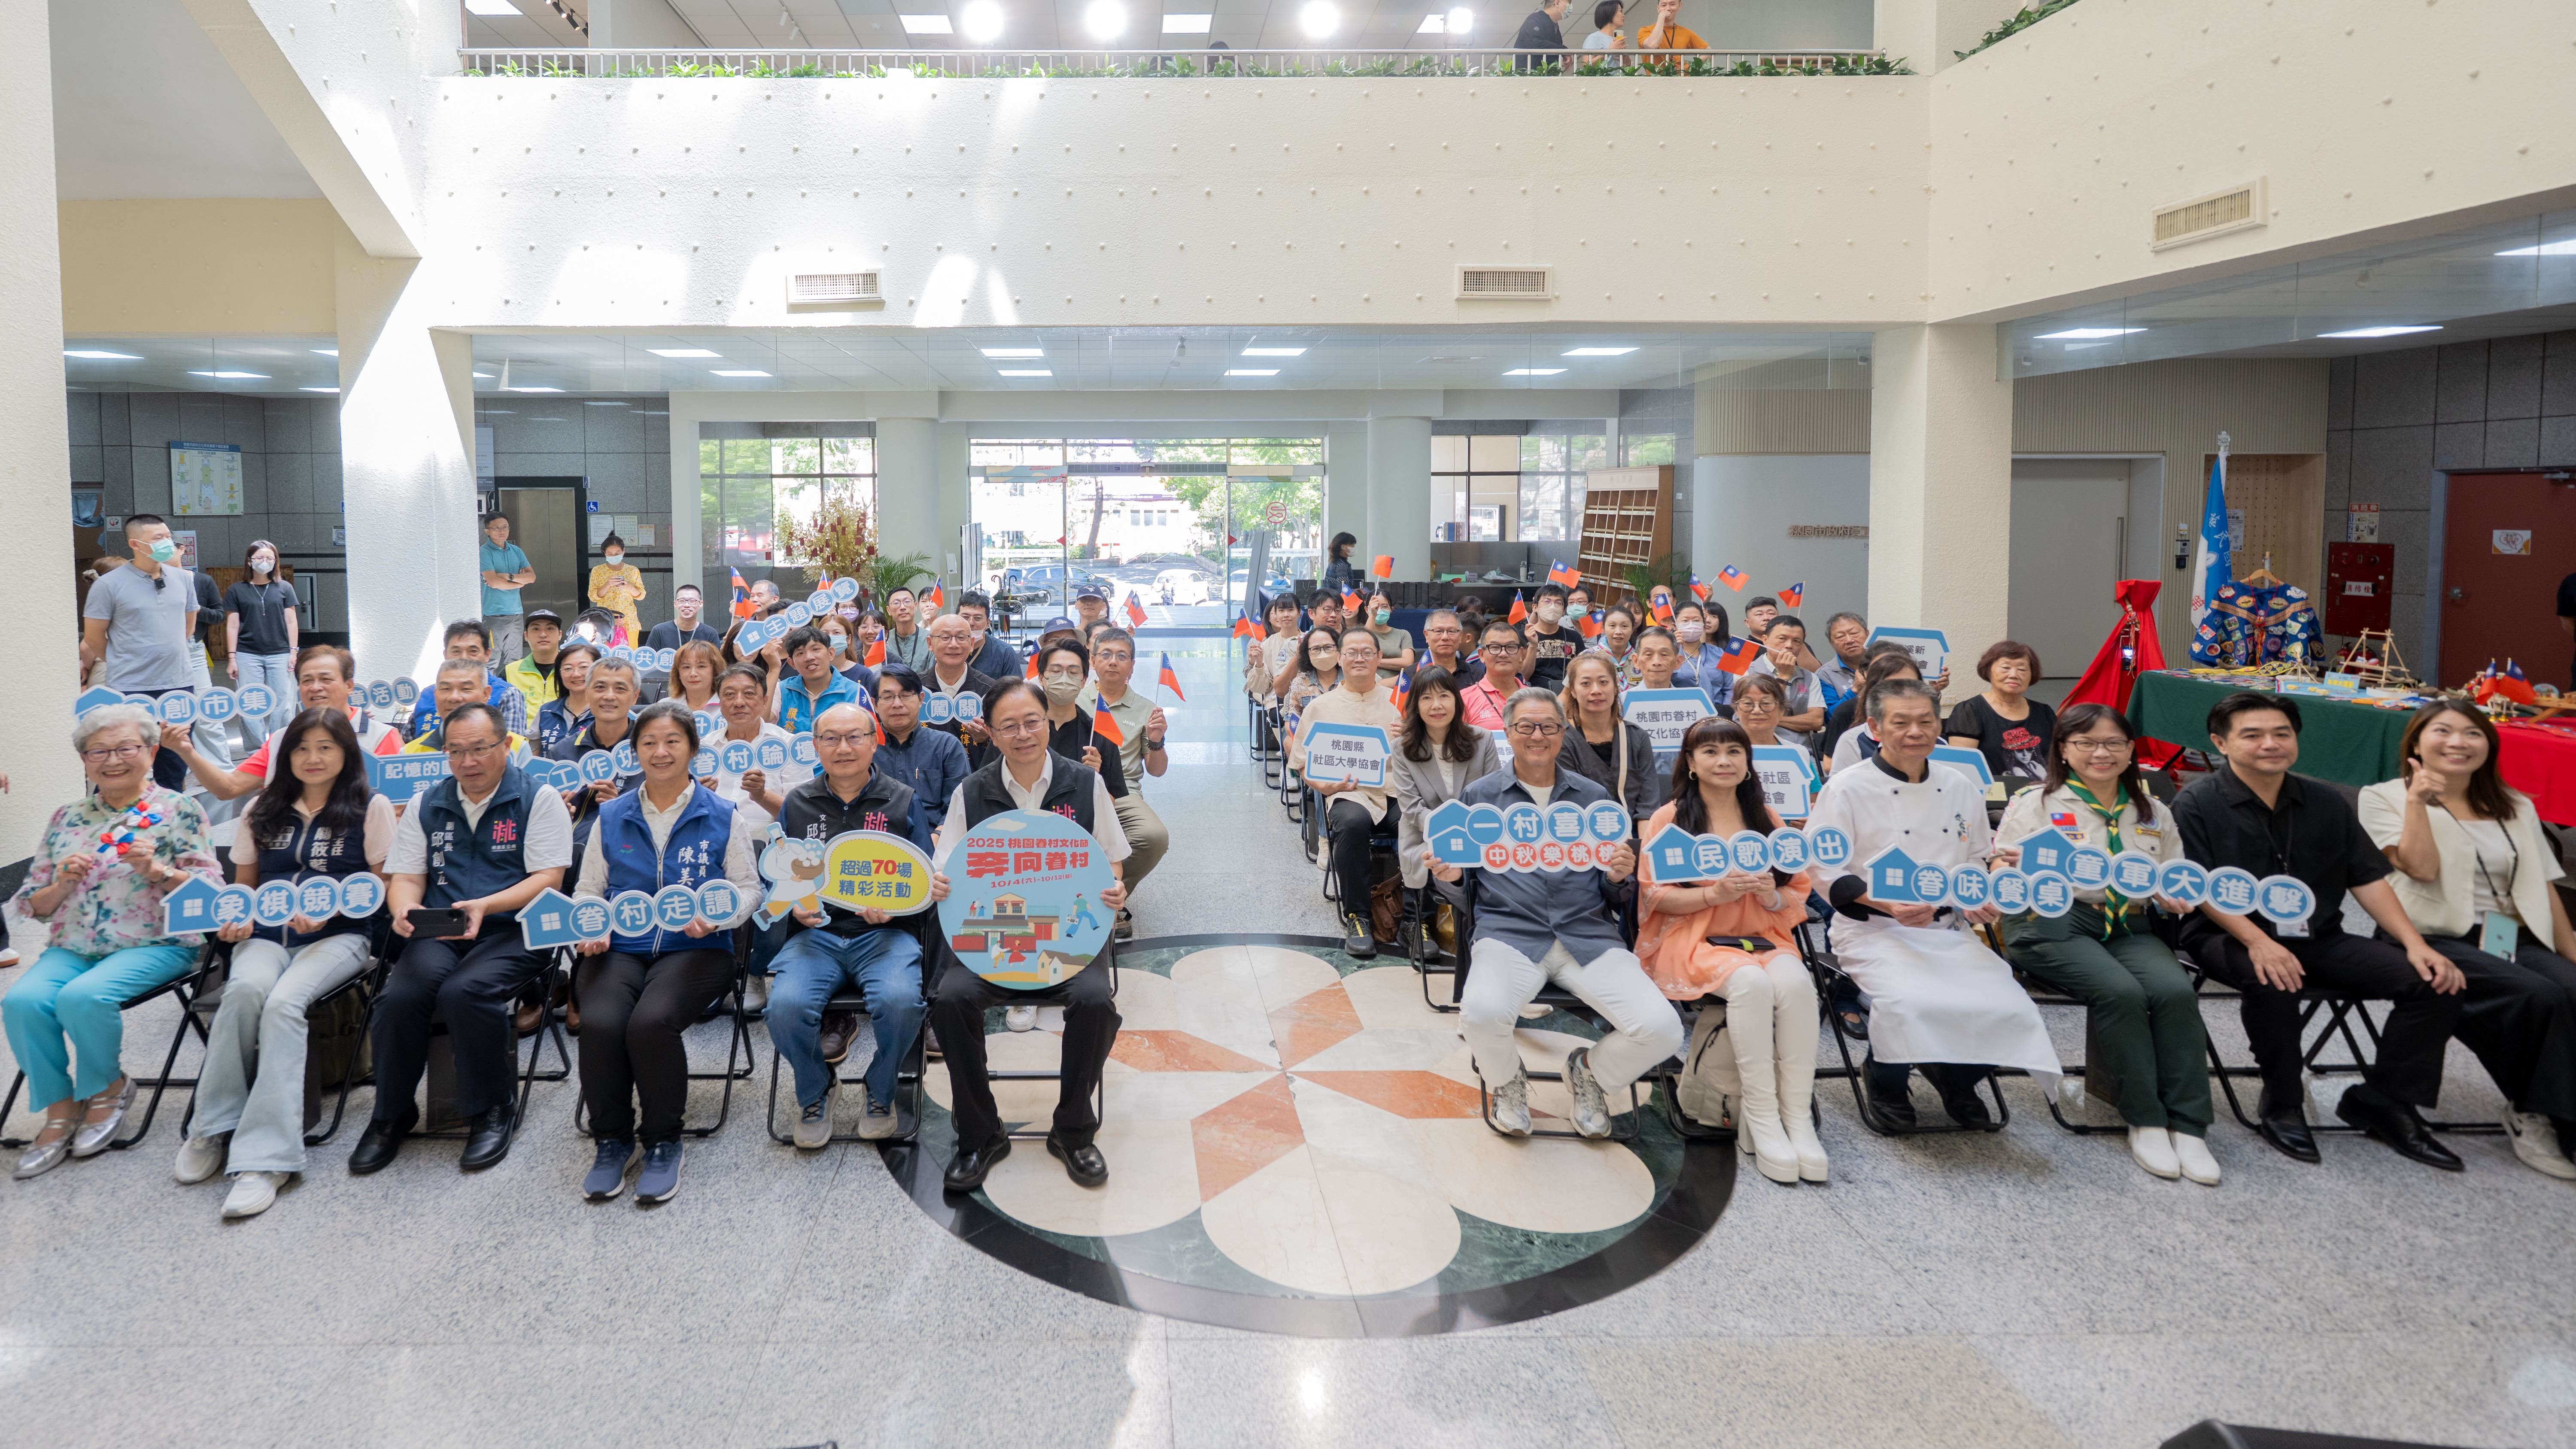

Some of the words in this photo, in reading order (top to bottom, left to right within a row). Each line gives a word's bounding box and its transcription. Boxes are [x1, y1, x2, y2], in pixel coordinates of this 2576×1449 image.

[2345, 584, 2371, 593] 消防栓
[766, 581, 853, 637] 主題展覽
[131, 691, 267, 719] 創市集
[349, 683, 413, 706] 章活動
[931, 699, 977, 717] 闖關
[1636, 710, 1697, 723] 桃園市眷村
[693, 740, 817, 774] 眷村論壇
[1331, 739, 1364, 752] 桃園縣
[1313, 754, 1380, 771] 社區大學協會
[444, 821, 455, 852] 副區長
[1473, 811, 1622, 838] 一村喜事
[966, 838, 1005, 848] 2025
[1008, 838, 1089, 848] 桃園眷村文化節
[1489, 844, 1617, 864] 中秋樂桃桃
[1698, 833, 1844, 870] 民歌演出
[698, 840, 710, 878] 市議員
[839, 859, 912, 878] 超過70場
[966, 851, 1089, 878] 奔向眷村
[839, 879, 911, 898] 精彩活動
[1917, 869, 2064, 908] 眷味餐桌
[2072, 853, 2303, 915] 童軍大進擊
[216, 882, 374, 921] 象棋競賽
[577, 889, 733, 932] 眷村走讀
